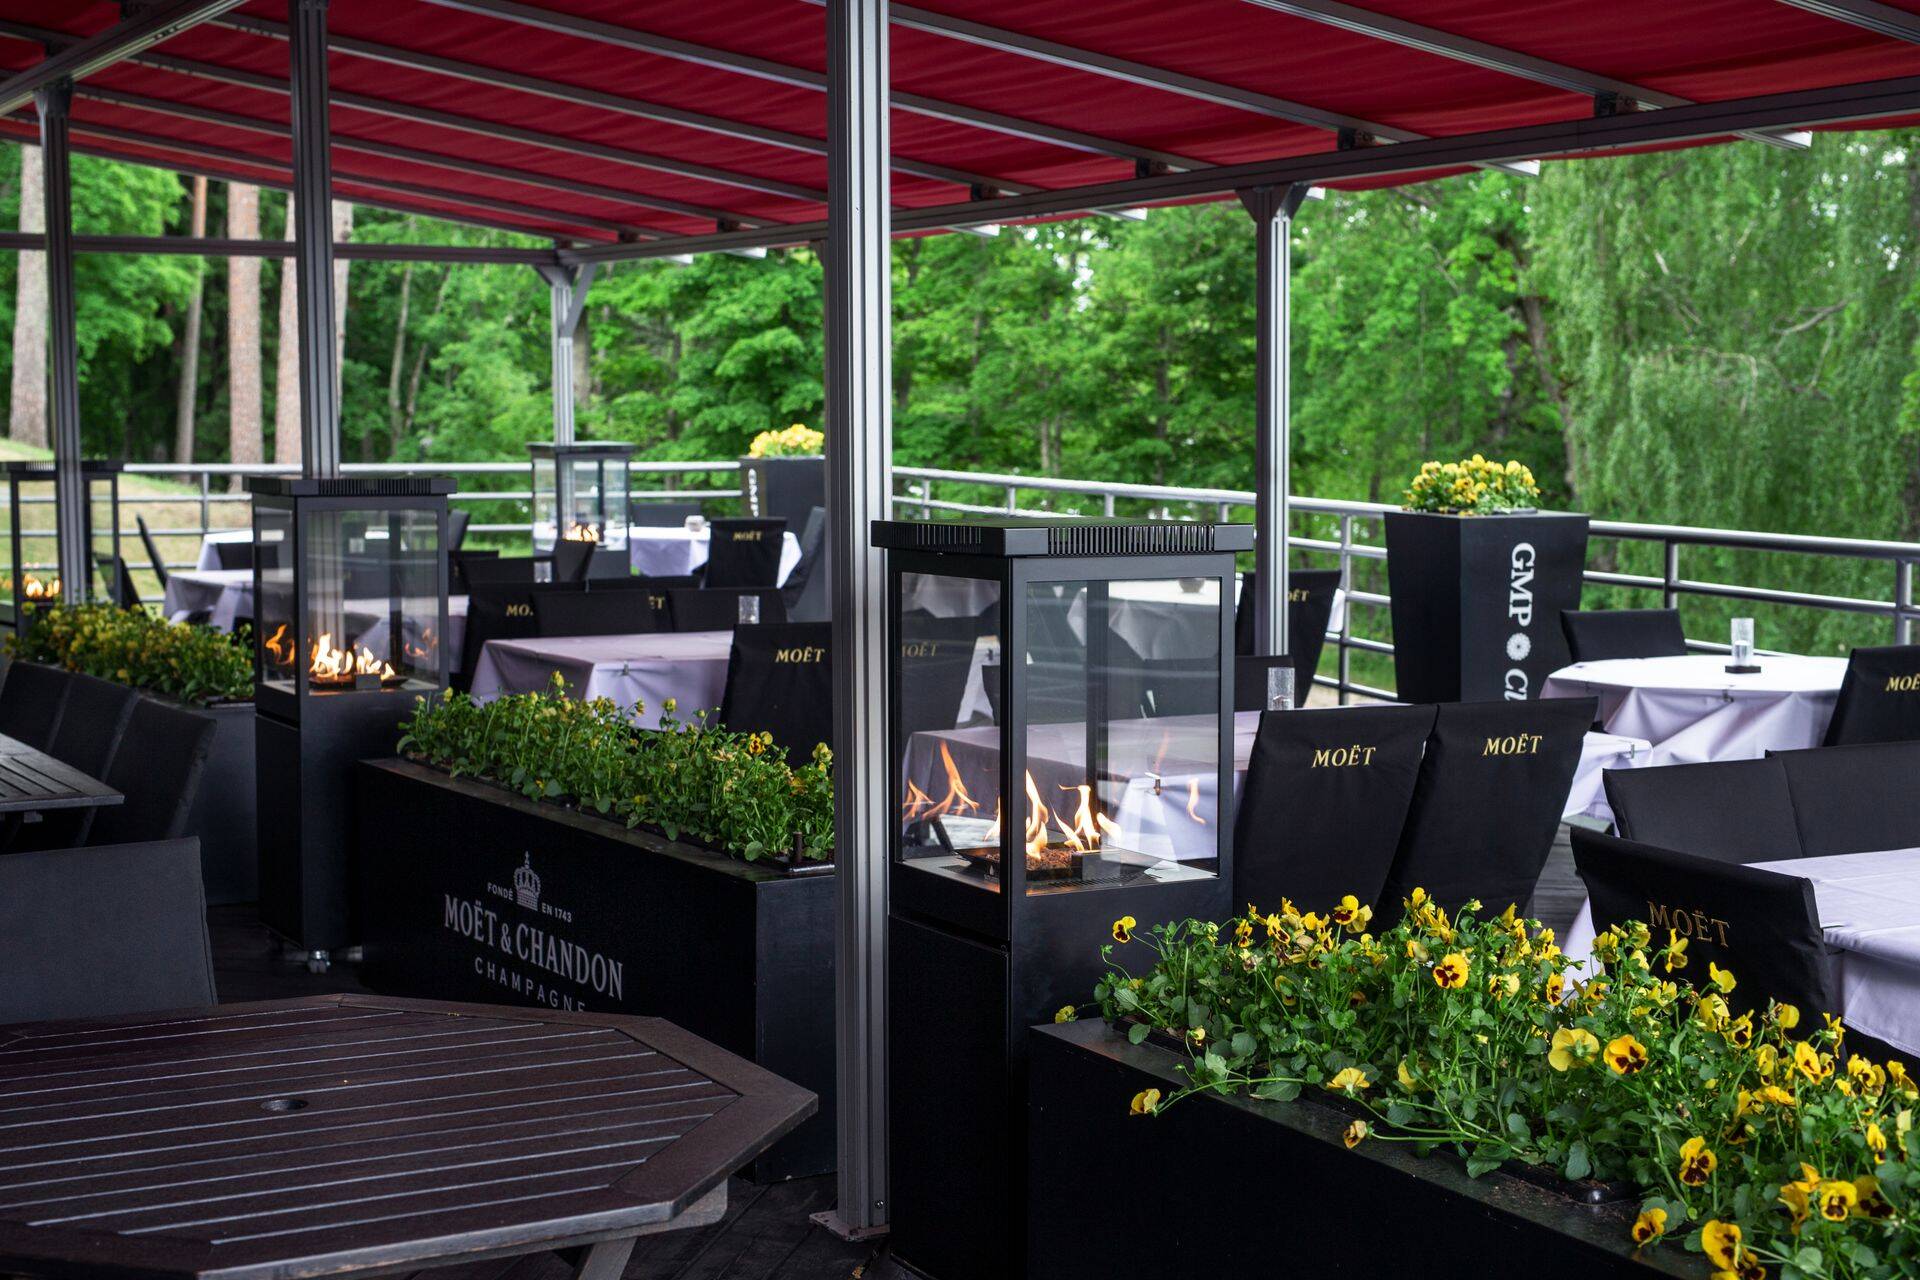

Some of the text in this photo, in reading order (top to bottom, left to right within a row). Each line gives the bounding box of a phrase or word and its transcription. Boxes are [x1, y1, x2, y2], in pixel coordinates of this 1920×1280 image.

[1509, 542, 1536, 627] GMP
[506, 604, 533, 616] MO
[775, 646, 825, 663] MOËT
[1885, 673, 1920, 691] MOË
[1311, 744, 1376, 768] MOËT
[1482, 733, 1543, 756] MOËT
[487, 882, 572, 923] FONDÉ EN 1743
[1647, 900, 1730, 948] MOËT
[444, 894, 623, 1001] MOËT & CHANDON
